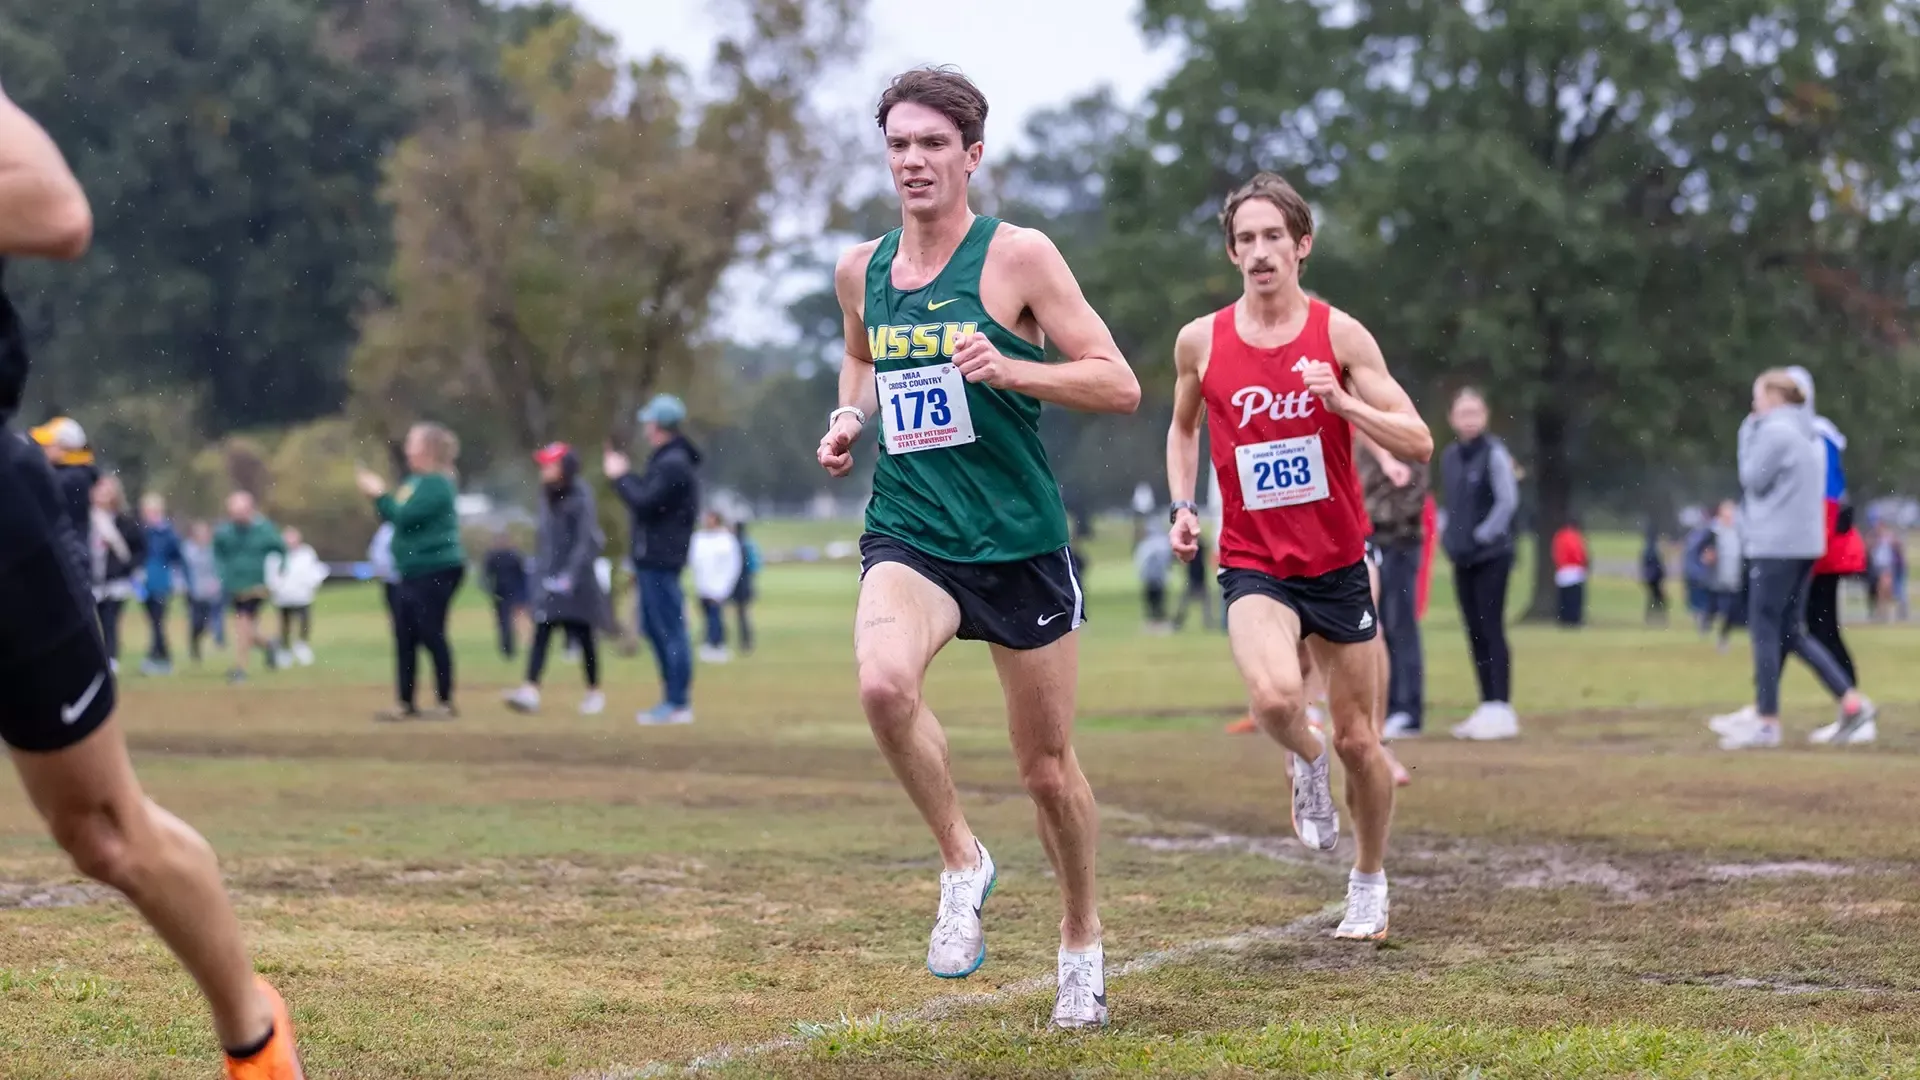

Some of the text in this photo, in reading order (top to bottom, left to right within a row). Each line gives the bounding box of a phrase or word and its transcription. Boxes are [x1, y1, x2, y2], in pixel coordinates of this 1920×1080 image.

[902, 371, 921, 380] MIAA
[888, 376, 942, 390] CROSS COUNTRY
[890, 388, 952, 432] 173
[1231, 385, 1315, 429] Pitt
[892, 432, 914, 442] HOSTED
[914, 431, 923, 439] BY
[897, 440, 917, 448] STATE
[918, 435, 953, 445] UNIVERSITY
[1253, 456, 1311, 491] 263
